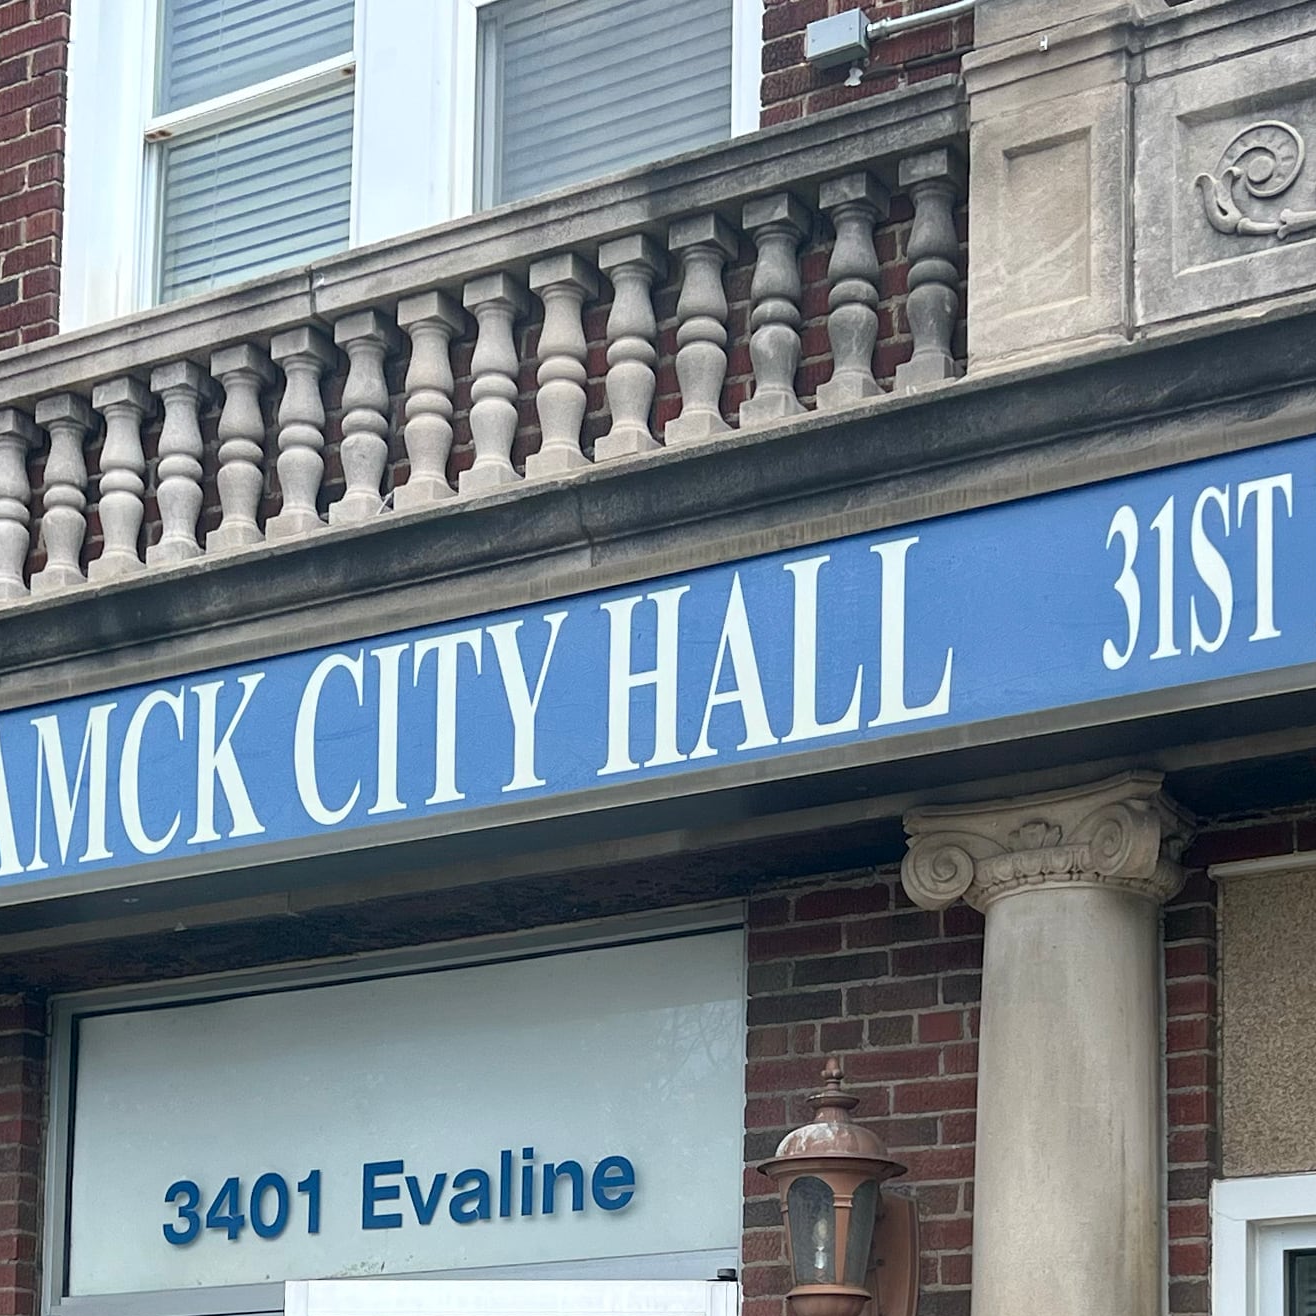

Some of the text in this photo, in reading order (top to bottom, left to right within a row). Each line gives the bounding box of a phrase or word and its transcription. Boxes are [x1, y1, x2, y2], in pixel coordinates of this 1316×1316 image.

[1103, 474, 1292, 669] 31ST
[295, 612, 568, 824] CITY
[597, 537, 952, 775] HALL
[163, 1147, 636, 1244] 3401 Evaline
